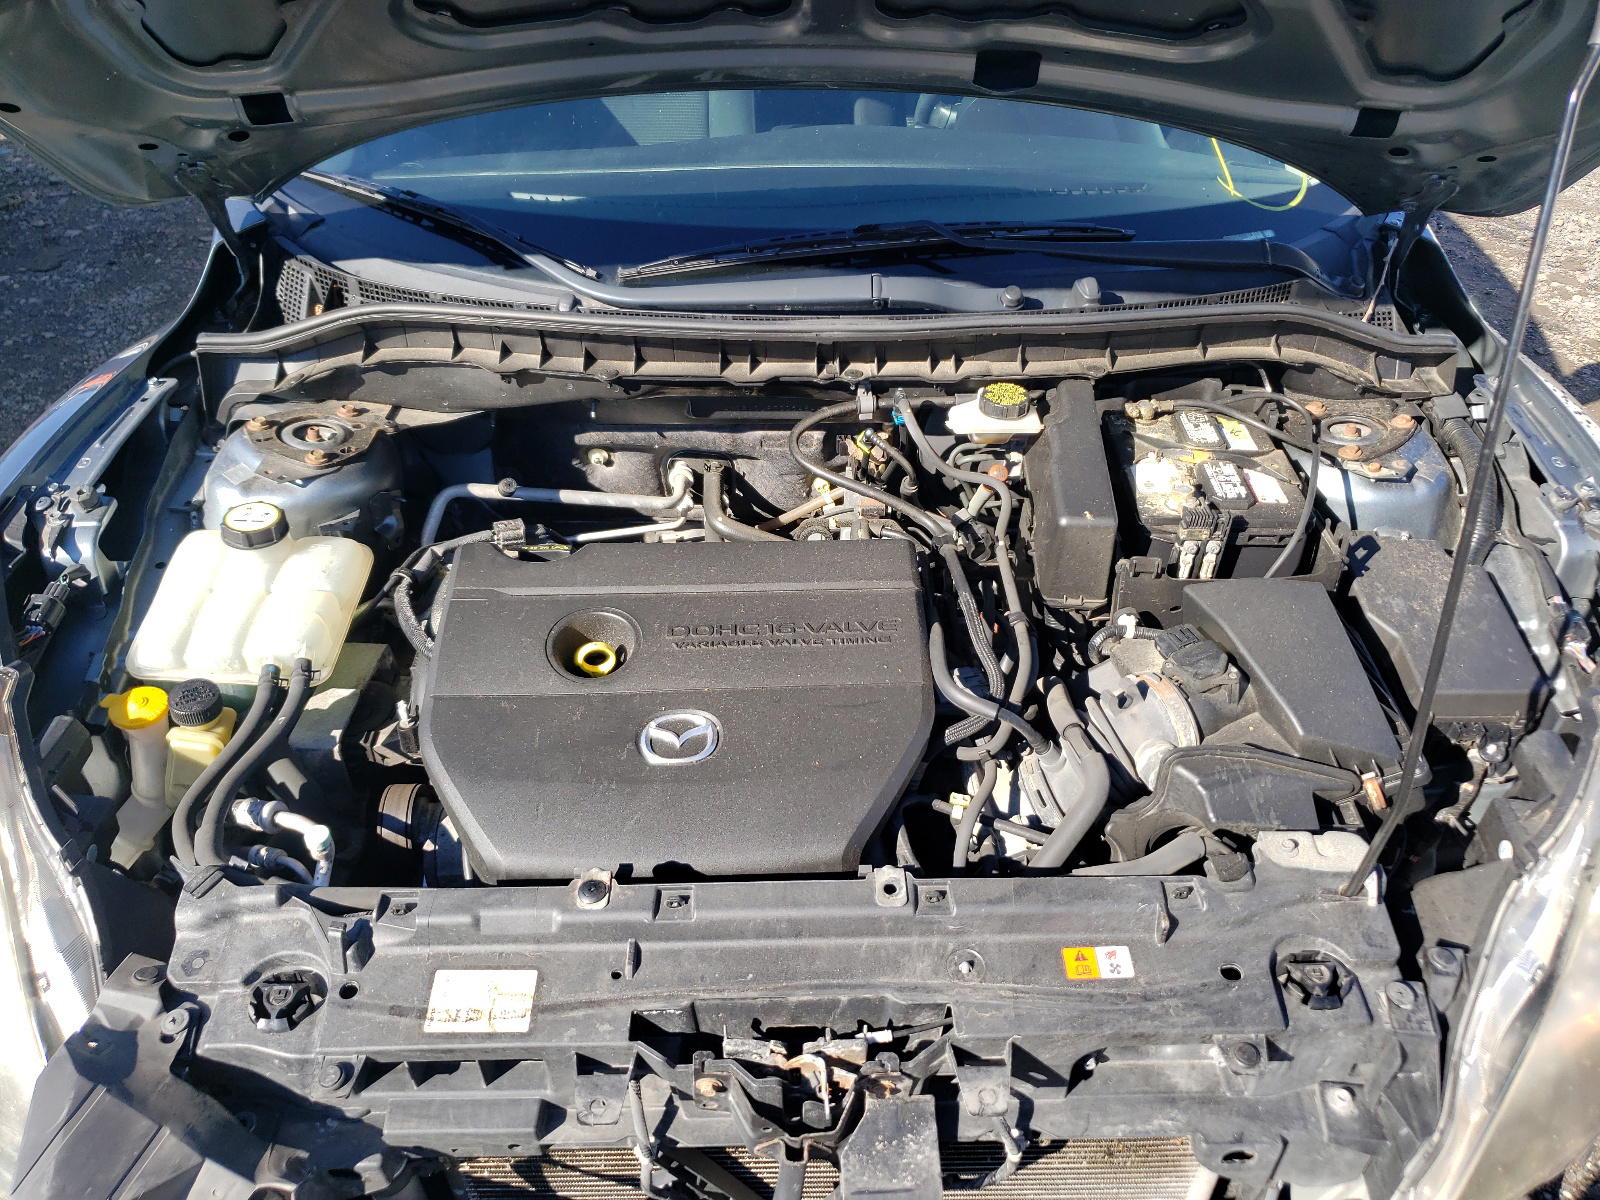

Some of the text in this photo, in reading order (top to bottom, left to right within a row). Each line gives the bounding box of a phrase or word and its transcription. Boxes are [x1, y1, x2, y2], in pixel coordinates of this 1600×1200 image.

[666, 618, 899, 638] DOHC 16-VALVE
[767, 637, 824, 648] VALVE
[826, 635, 892, 646] TIMING
